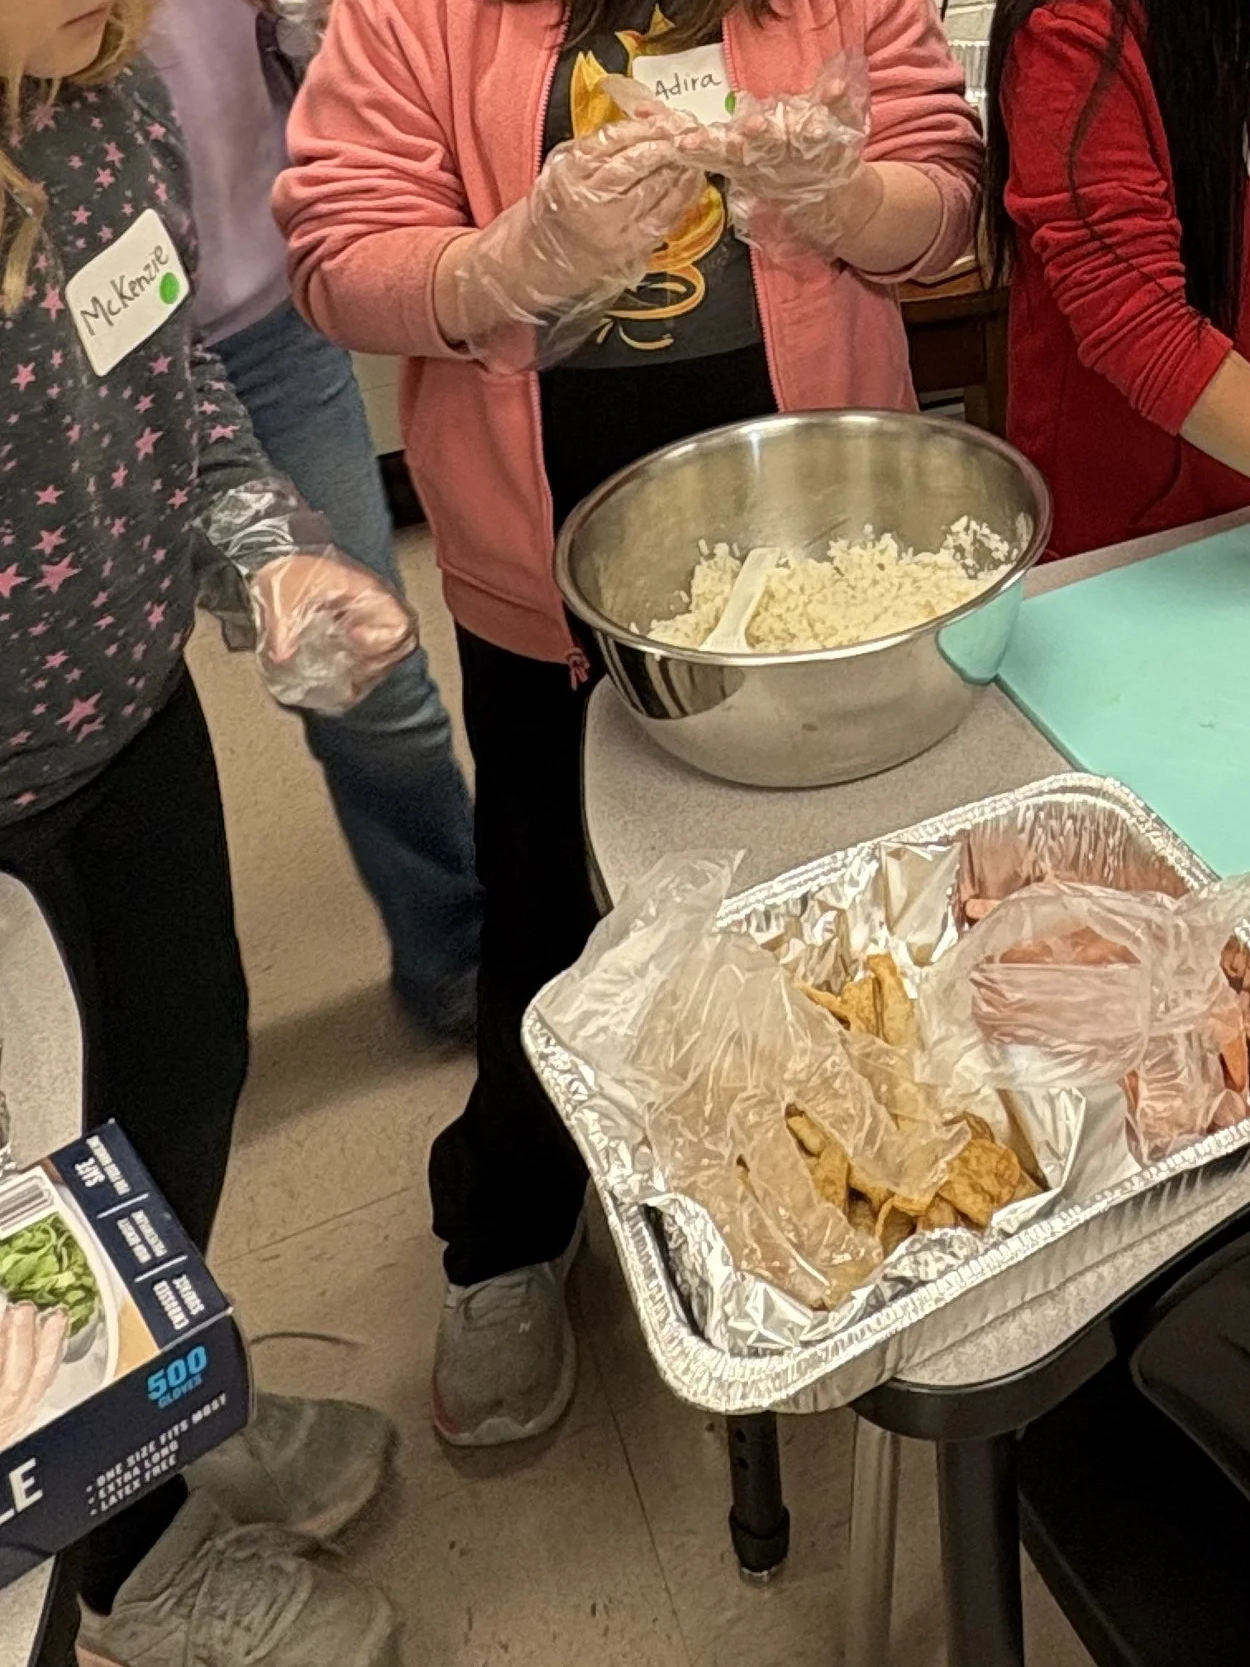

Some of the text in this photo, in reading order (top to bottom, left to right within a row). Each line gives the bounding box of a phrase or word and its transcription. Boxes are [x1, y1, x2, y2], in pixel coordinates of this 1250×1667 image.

[654, 73, 722, 100] Adira
[80, 244, 169, 336] McKenzie
[147, 1345, 208, 1401] 500
[96, 1392, 227, 1487] ONE SIZE FITS MOST
[98, 1439, 179, 1500] EXTRA LONG
[101, 1453, 177, 1512] LATEX FREE
